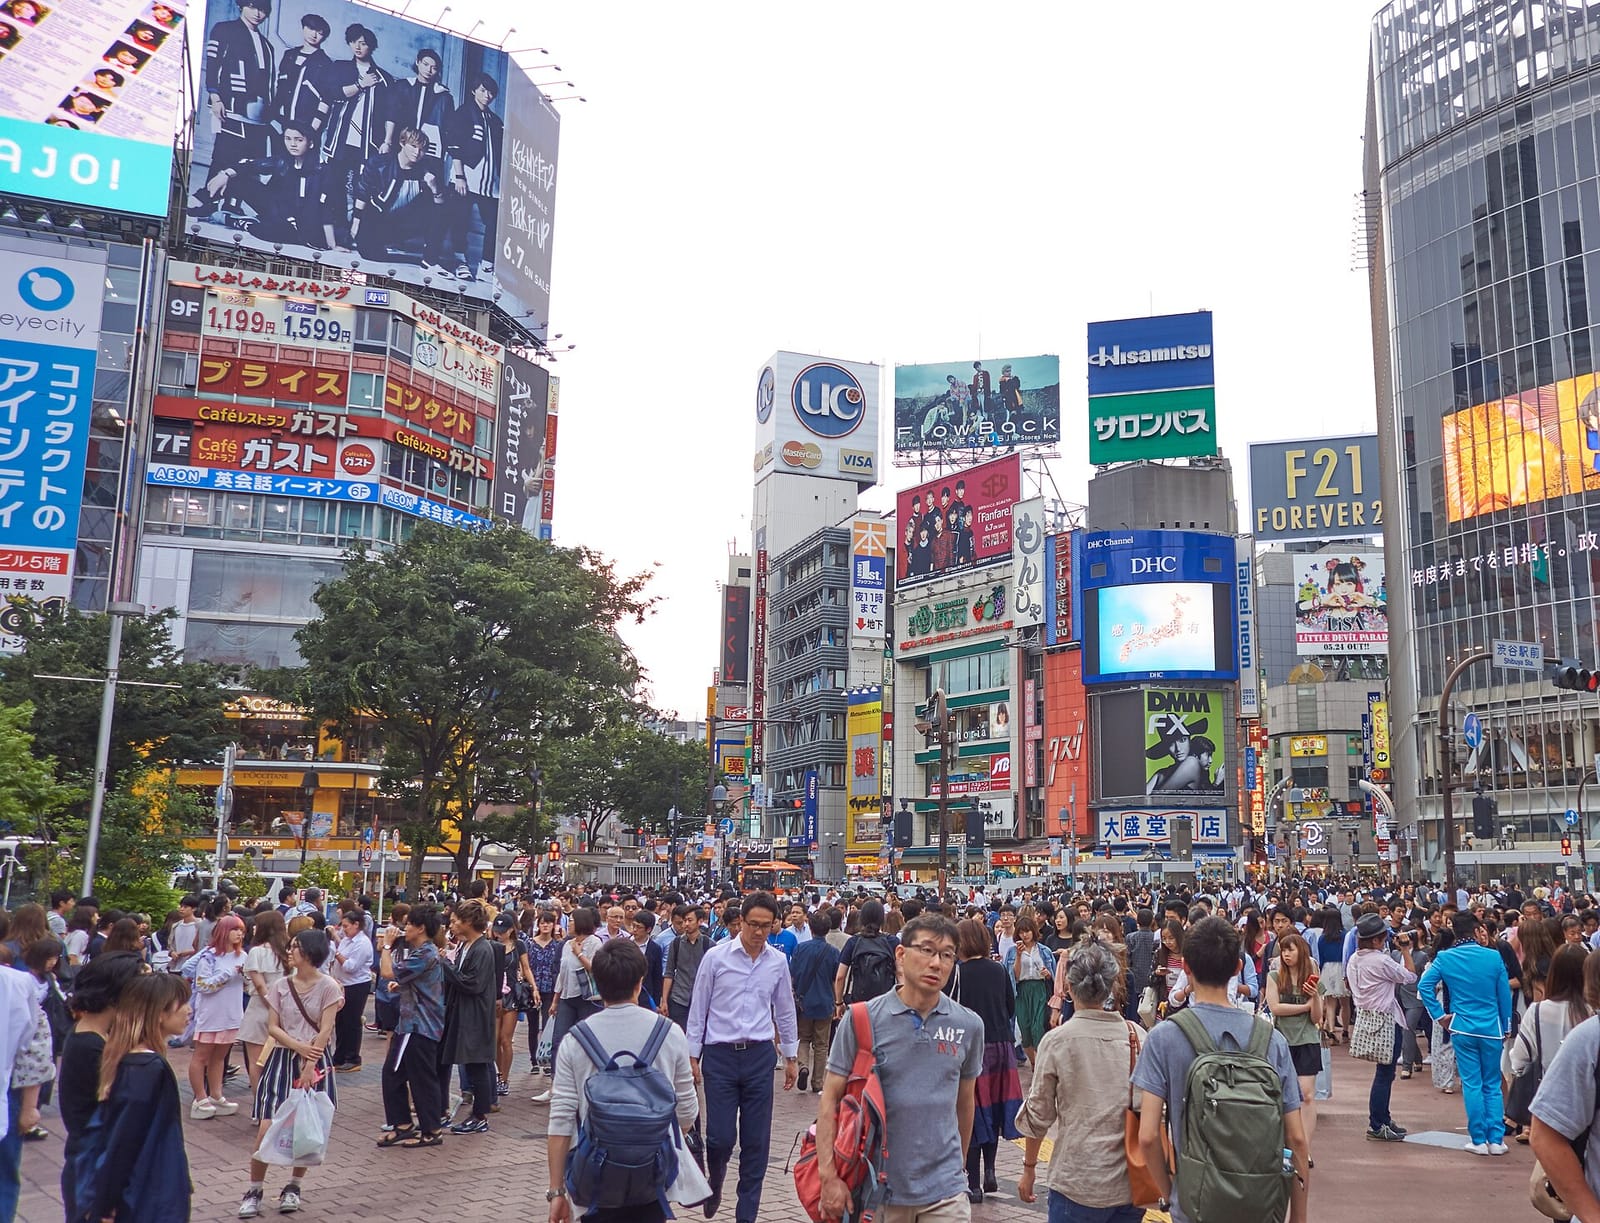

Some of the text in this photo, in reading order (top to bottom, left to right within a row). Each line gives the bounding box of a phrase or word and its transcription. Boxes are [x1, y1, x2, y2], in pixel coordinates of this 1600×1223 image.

[527, 191, 549, 215] SINGLE
[503, 236, 550, 295] 6.7 ON SALE
[171, 299, 199, 317] 9F
[0, 313, 85, 338] eyecity
[1088, 344, 1211, 367] Hisamitsu
[203, 361, 343, 396] プライス
[386, 383, 471, 434] コンタクト
[290, 411, 358, 438] ガスト
[1094, 408, 1210, 441] サロンパス
[32, 363, 80, 532] コンタクトの
[154, 434, 191, 453] 7F
[198, 437, 238, 452] Café
[782, 448, 821, 459] MasterCard
[240, 439, 328, 473] ガスト
[449, 448, 487, 477] ガスト
[843, 454, 873, 468] VISA
[155, 467, 200, 483] AEON
[214, 471, 342, 496] 英会話イーオン
[1286, 446, 1363, 499] F21
[387, 490, 415, 509] AEON
[1257, 500, 1383, 532] FOREVER 2
[854, 522, 886, 557] 本
[1087, 536, 1134, 549] DHC Channel
[1130, 556, 1177, 574] DHC
[1412, 530, 1599, 588] 年度末までを目指す。 政
[855, 591, 883, 604] 夜11時
[860, 603, 878, 614] まで
[866, 618, 883, 630] 地下
[1238, 556, 1252, 669] Taisei neon
[1360, 633, 1388, 642] PARAD
[1497, 643, 1540, 660] 渋谷駅前
[1147, 691, 1211, 713] DMM
[1148, 713, 1190, 736] FX
[1048, 719, 1084, 787] クスリ
[728, 758, 744, 773] 薬
[991, 756, 1011, 776] JTB
[1104, 815, 1220, 838] 大盛堂店
[933, 1026, 965, 1044] A87
